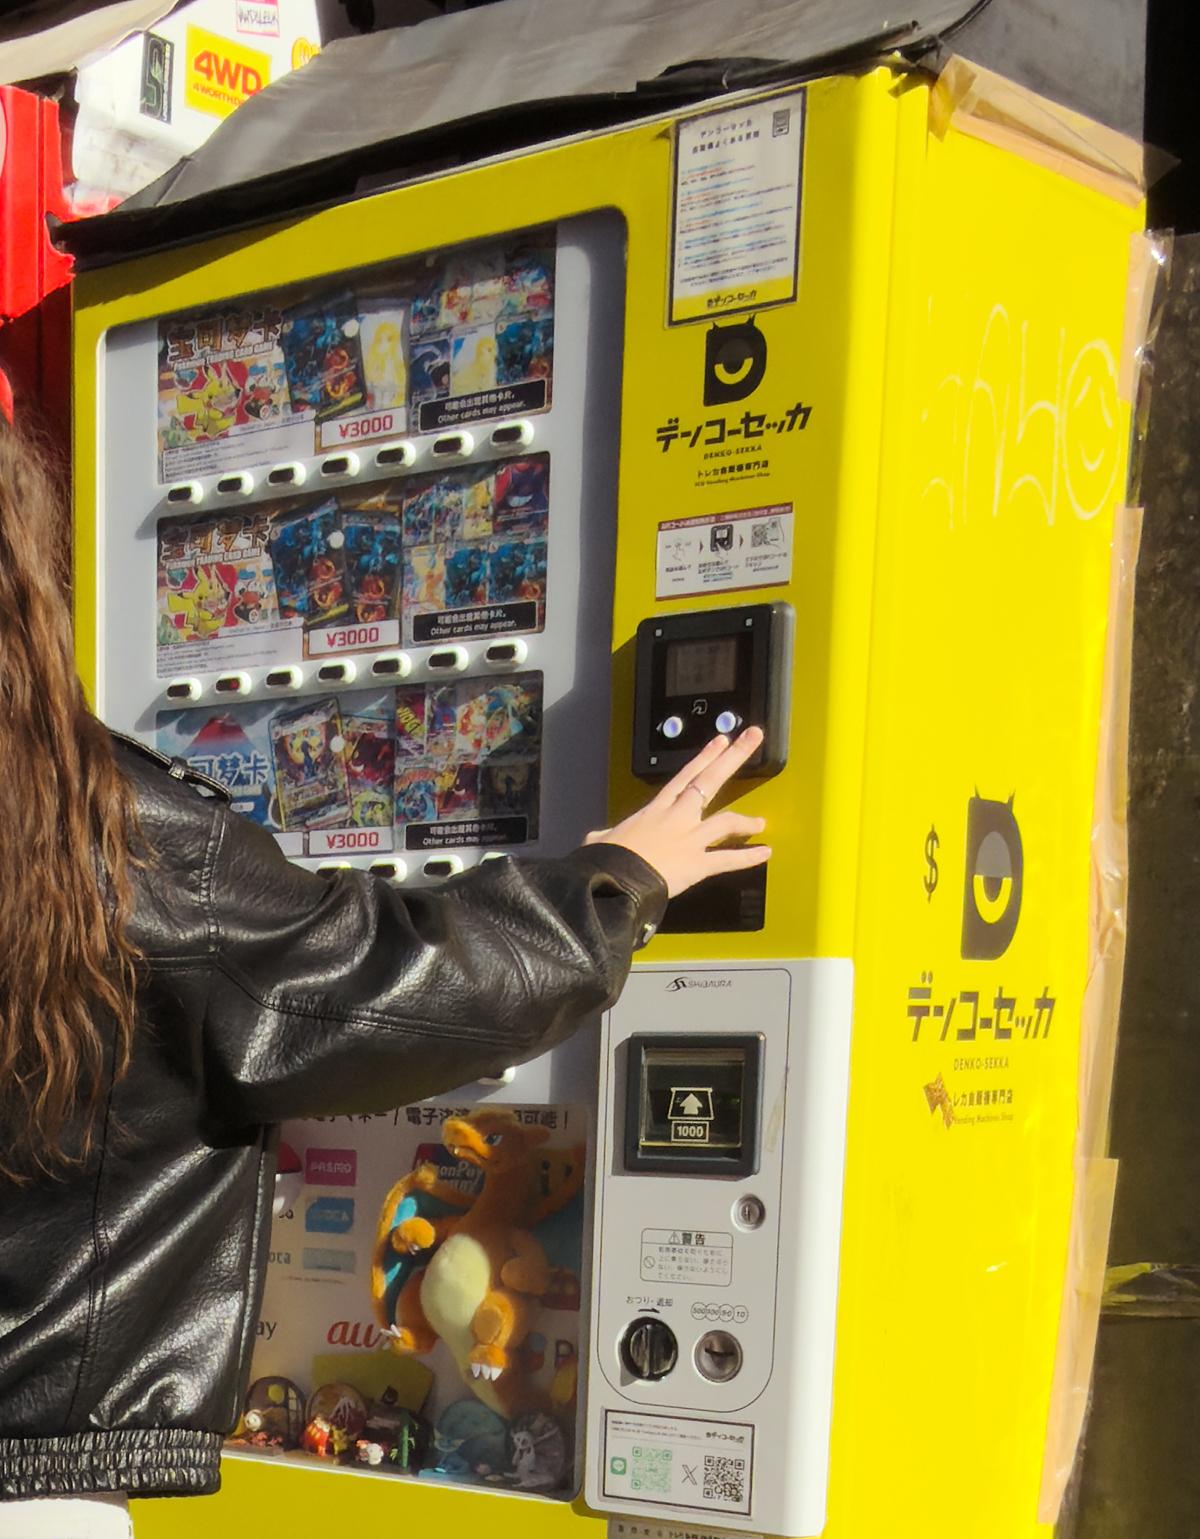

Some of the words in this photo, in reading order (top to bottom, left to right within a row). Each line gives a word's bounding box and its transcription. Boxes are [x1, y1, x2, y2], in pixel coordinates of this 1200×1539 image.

[194, 50, 262, 97] 4WD
[339, 415, 393, 438] ¥3000
[326, 627, 379, 648] ¥3000
[430, 626, 451, 636] Other
[453, 624, 473, 633] cards
[474, 623, 488, 631] may
[326, 831, 379, 849] ¥3000
[422, 837, 443, 846] Other
[953, 1089, 1013, 1107] レカ自販機専門店
[677, 1126, 704, 1137] 1000
[693, 1307, 705, 1315] 500
[721, 1309, 732, 1317] 50
